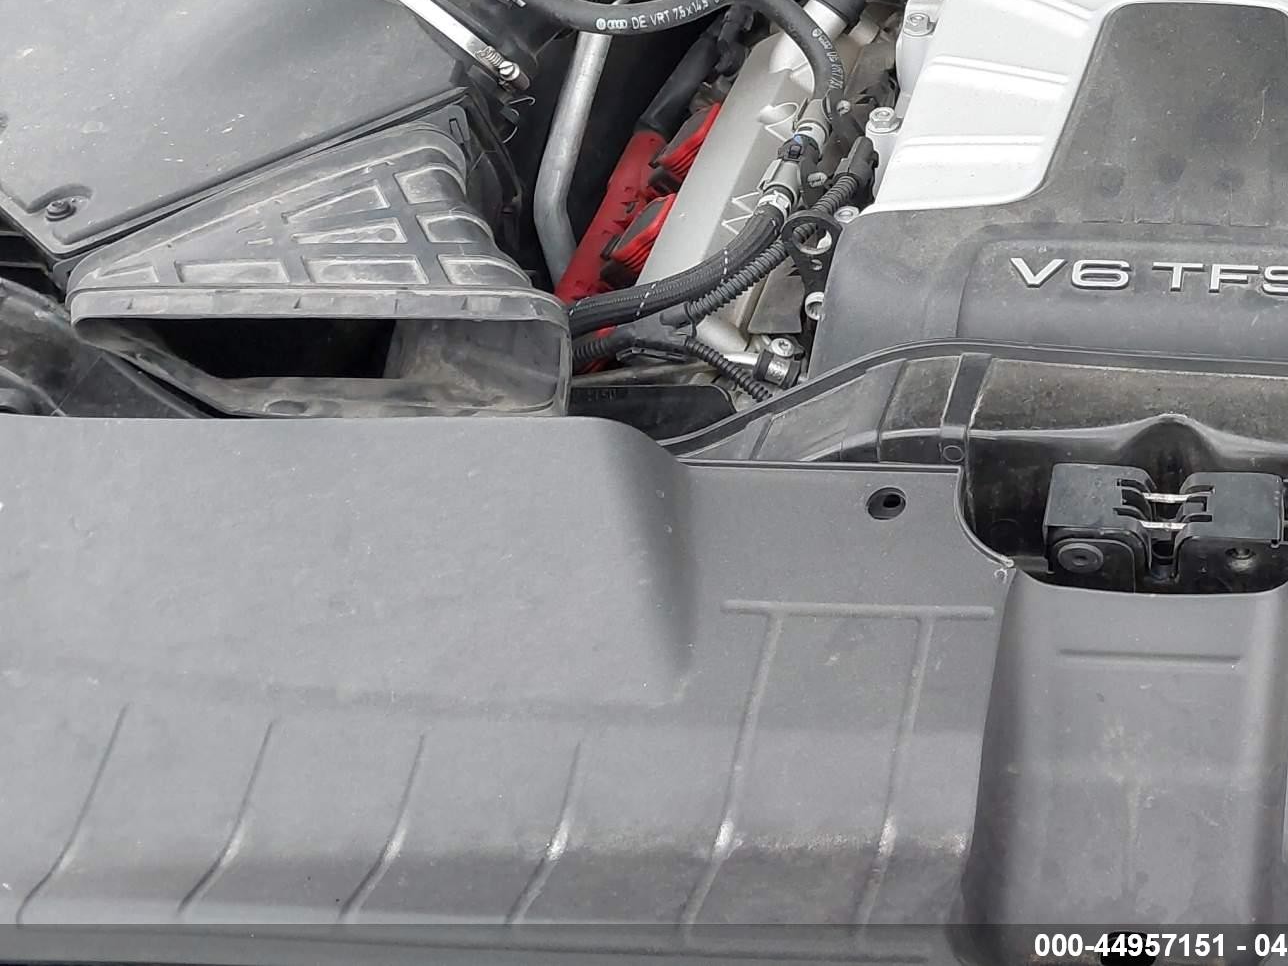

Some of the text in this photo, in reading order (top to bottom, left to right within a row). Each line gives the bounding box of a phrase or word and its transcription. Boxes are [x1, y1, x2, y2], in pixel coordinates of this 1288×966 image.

[631, 14, 648, 30] DE
[650, 10, 671, 26] VRT
[1010, 257, 1132, 289] V6
